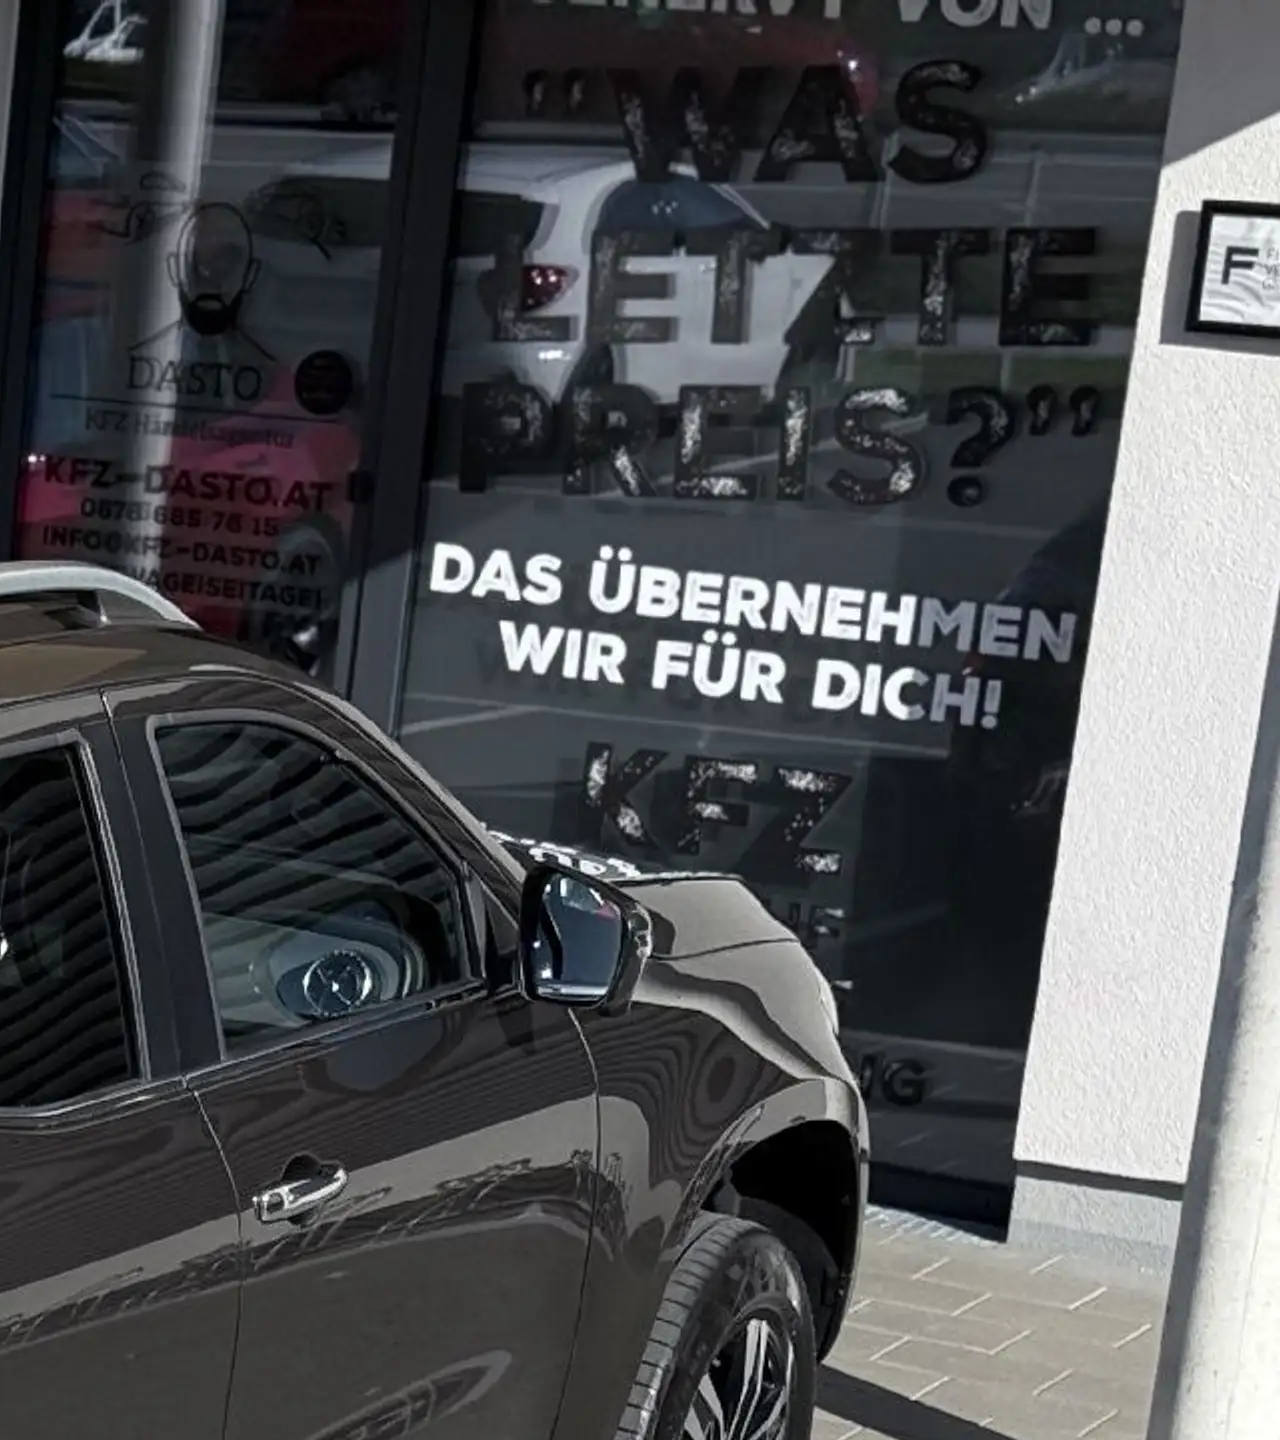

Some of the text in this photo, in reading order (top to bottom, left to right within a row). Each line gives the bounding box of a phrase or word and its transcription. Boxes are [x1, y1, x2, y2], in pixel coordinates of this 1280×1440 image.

[493, 226, 1096, 346] LETZTE
[85, 407, 130, 432] KFZ
[127, 354, 263, 401] DASTO
[43, 457, 334, 513] KFZ-DASTO.AT
[430, 543, 1077, 664] DAS ÜBERNEHMEN
[498, 619, 1002, 730] WIR FÜR DICH!
[583, 742, 853, 882] KFZ
